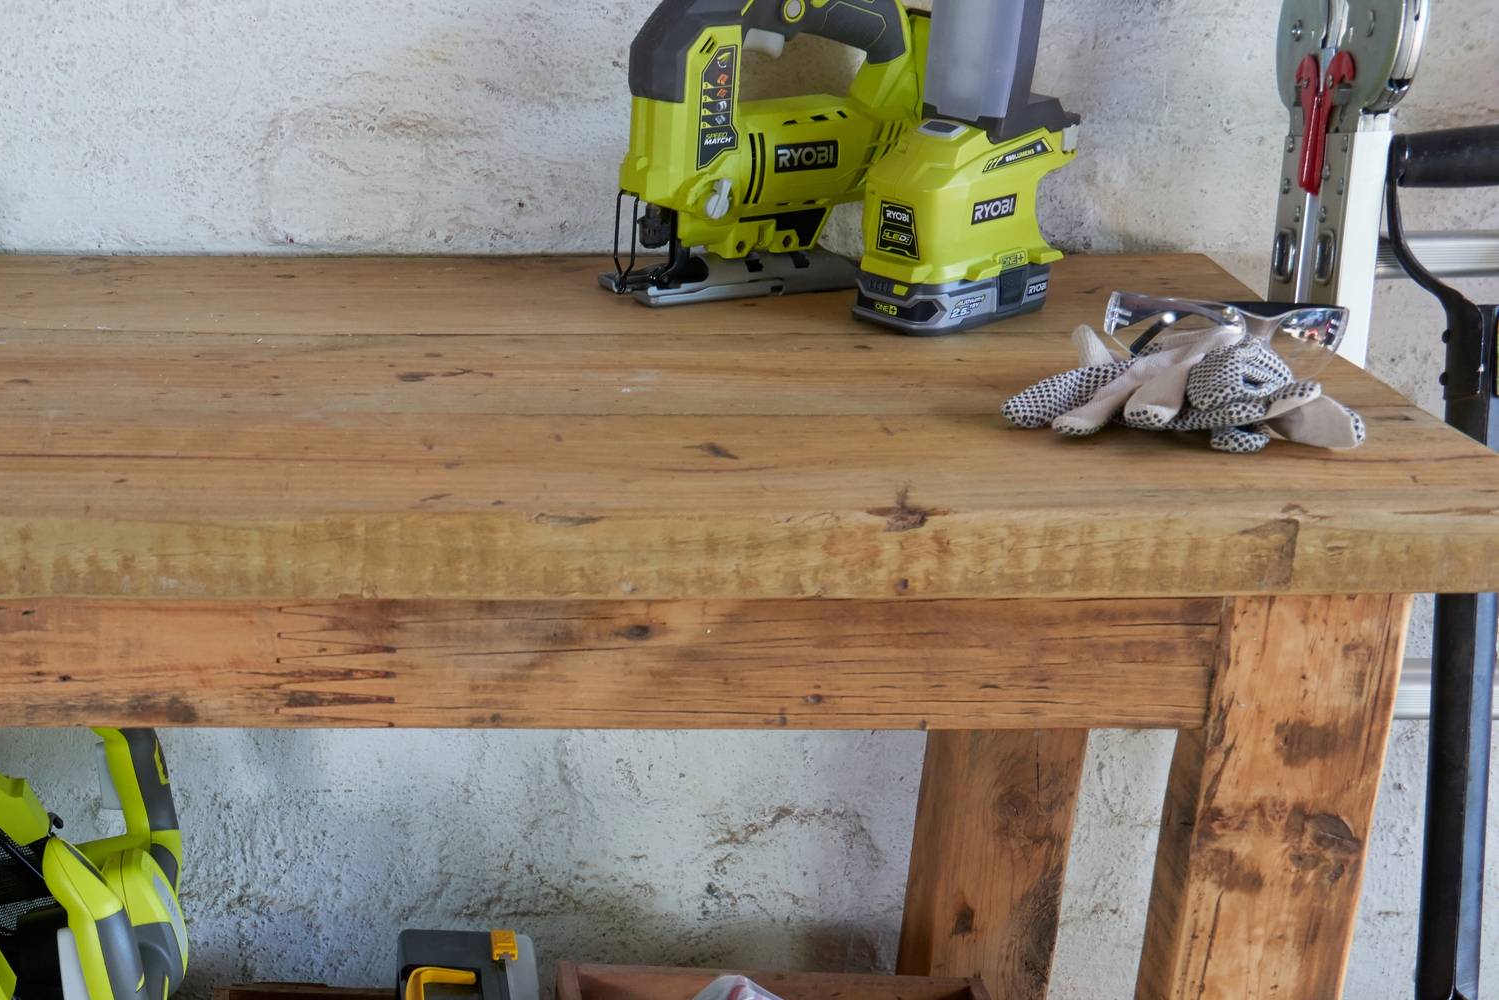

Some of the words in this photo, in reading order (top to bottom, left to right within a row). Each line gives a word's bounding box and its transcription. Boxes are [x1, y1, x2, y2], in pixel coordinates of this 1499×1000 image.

[704, 137, 731, 146] MATCH
[777, 145, 834, 168] RYOBI
[885, 209, 910, 222] RYOBI
[974, 197, 1014, 221] RYOBI
[1028, 282, 1047, 295] RYOBI
[875, 303, 898, 316] ONE+
